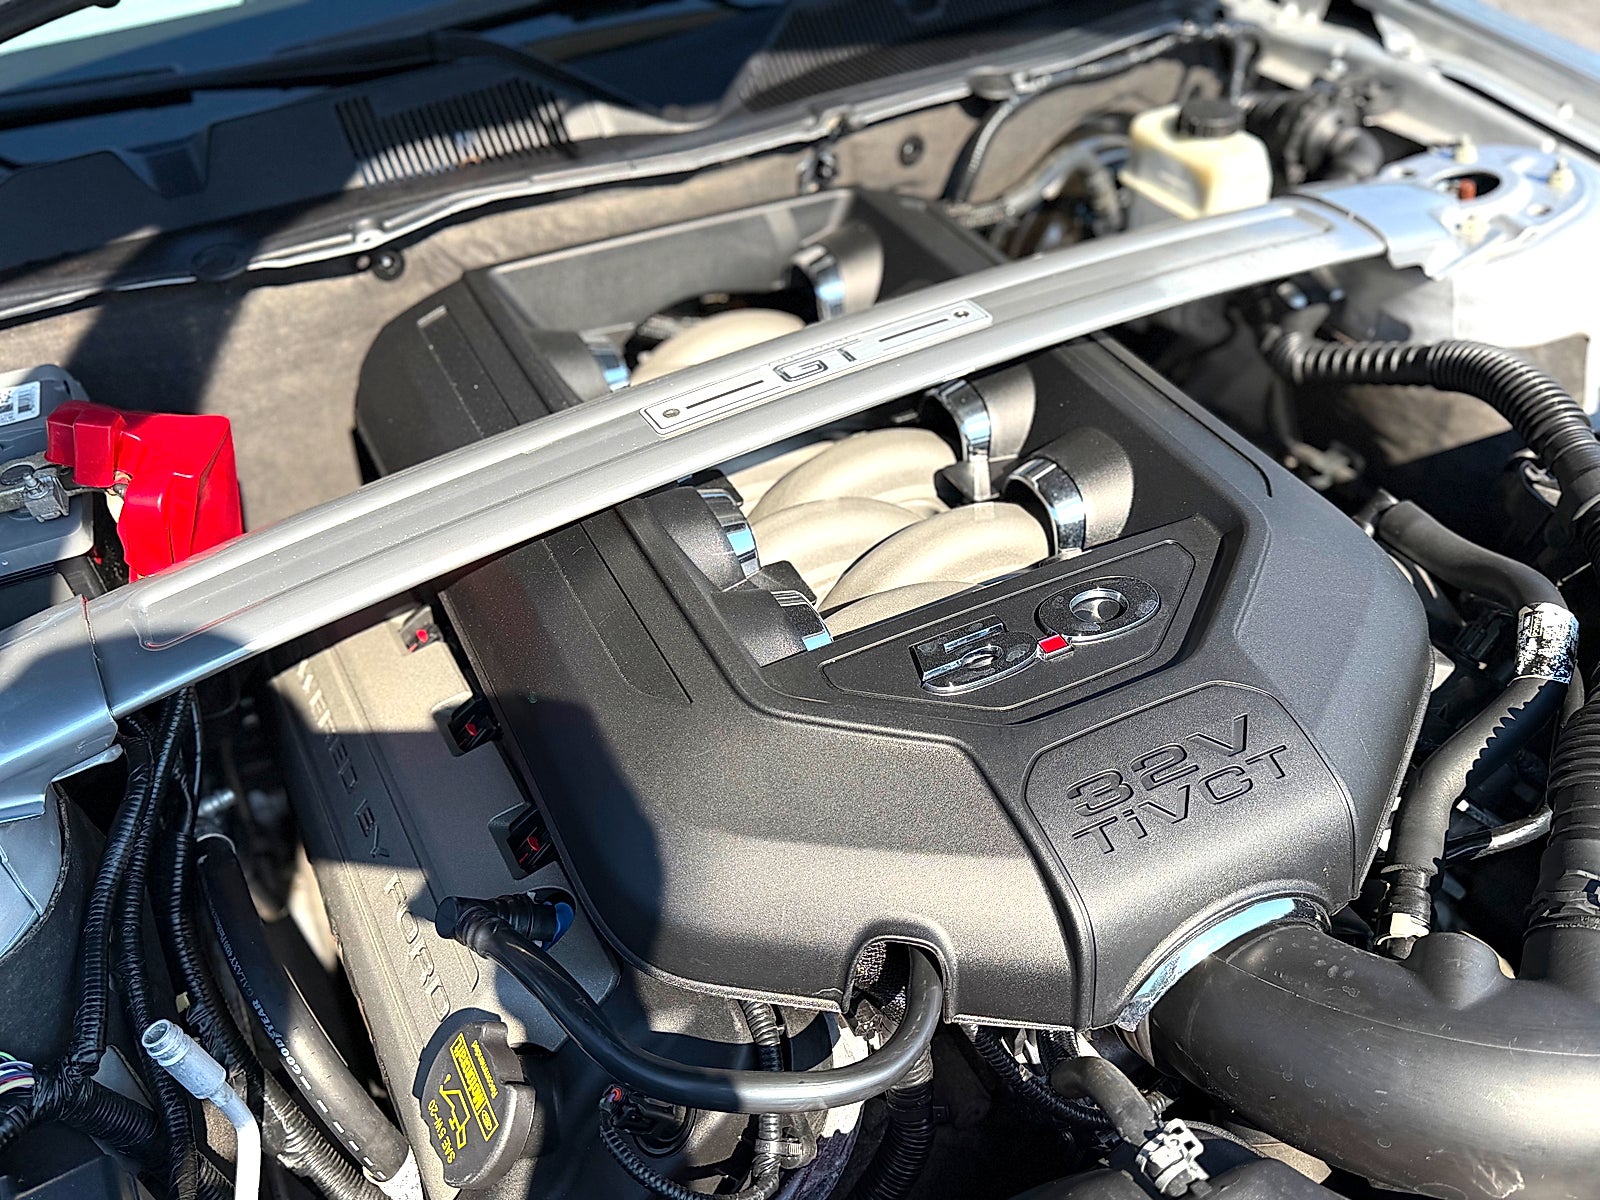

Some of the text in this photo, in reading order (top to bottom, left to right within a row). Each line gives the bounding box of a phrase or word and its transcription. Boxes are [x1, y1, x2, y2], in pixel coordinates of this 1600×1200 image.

[907, 574, 1162, 697] 5.0
[1066, 712, 1249, 818] 32V
[1071, 743, 1288, 855] TiVCT
[296, 659, 451, 1023] WERED BY FORD
[228, 956, 254, 997] GALAXY
[251, 998, 302, 1075] GOODYEAR
[453, 1036, 486, 1115] Motorcraft
[471, 1038, 499, 1100] Recommended
[427, 1098, 457, 1164] SAE 5W-20
